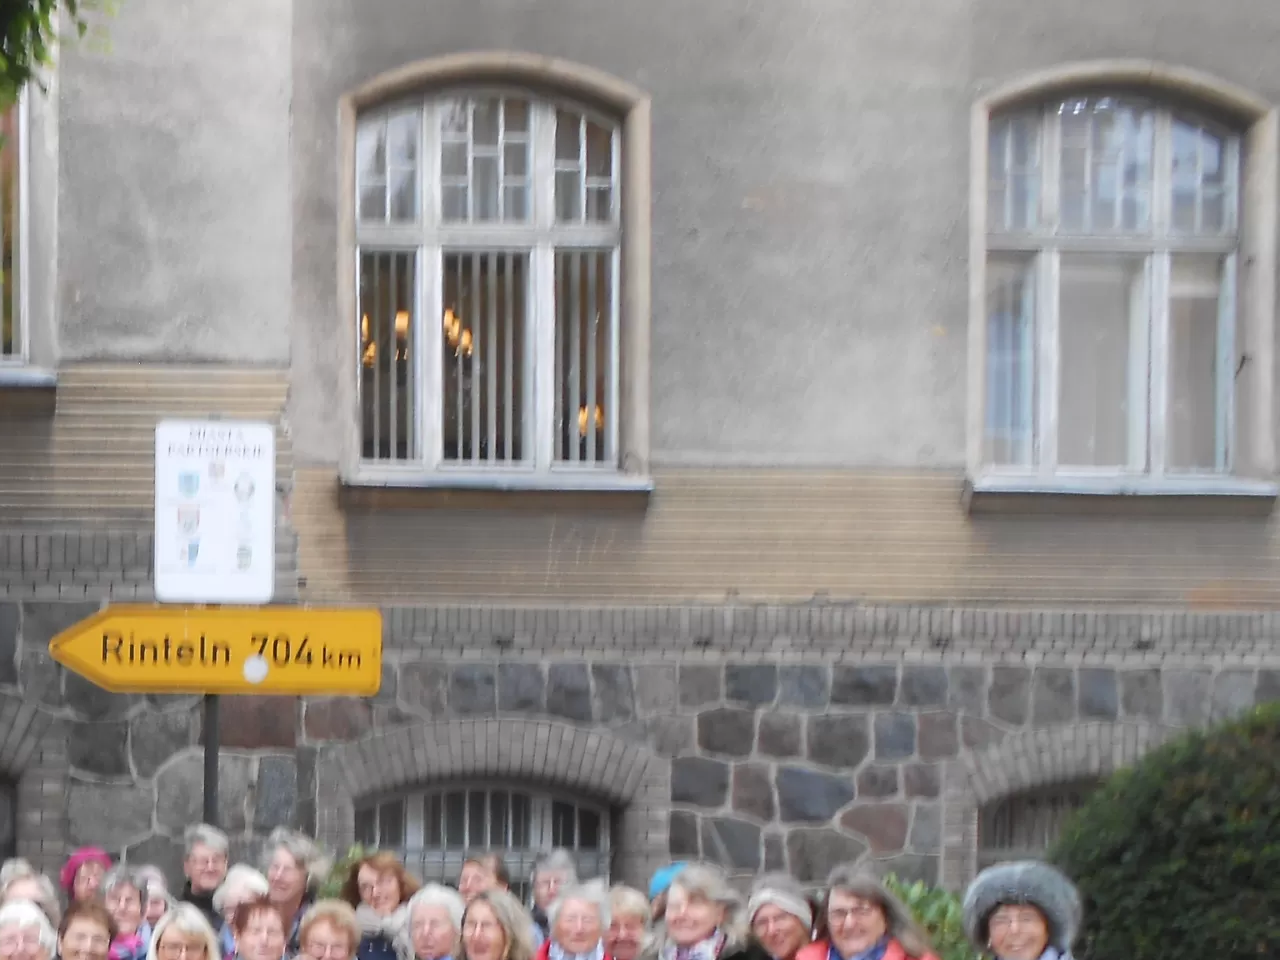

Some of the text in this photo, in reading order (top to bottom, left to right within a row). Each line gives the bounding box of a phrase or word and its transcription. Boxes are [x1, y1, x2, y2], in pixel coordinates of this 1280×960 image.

[101, 631, 361, 670] Rinteln 704 km
